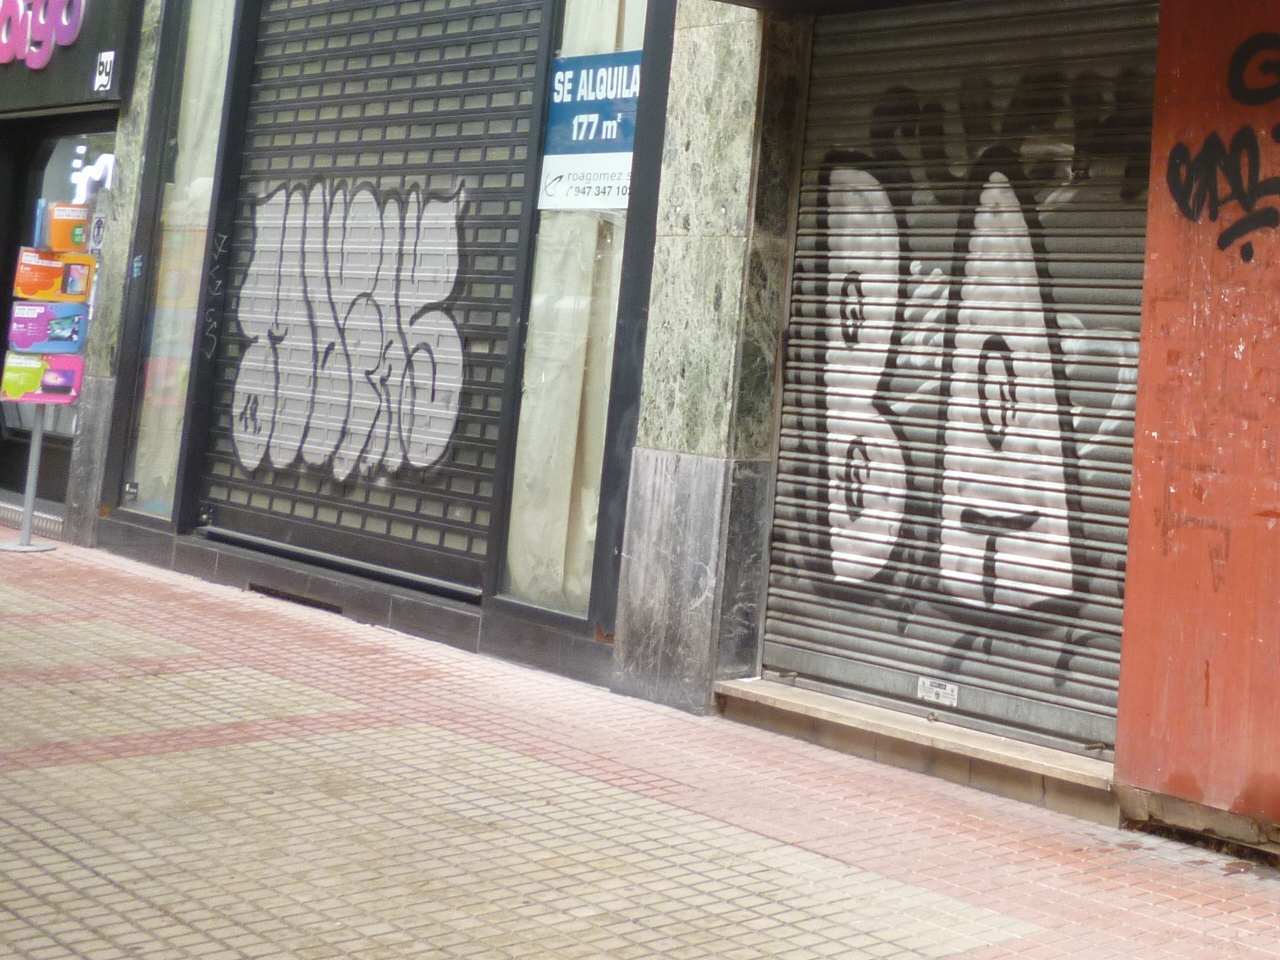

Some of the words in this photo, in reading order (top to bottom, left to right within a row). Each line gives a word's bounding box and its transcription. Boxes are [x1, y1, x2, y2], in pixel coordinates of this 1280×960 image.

[553, 70, 573, 103] SE
[577, 64, 641, 102] ALQUILA
[572, 114, 599, 141] 177
[574, 185, 593, 197] 947
[594, 185, 613, 197] 347
